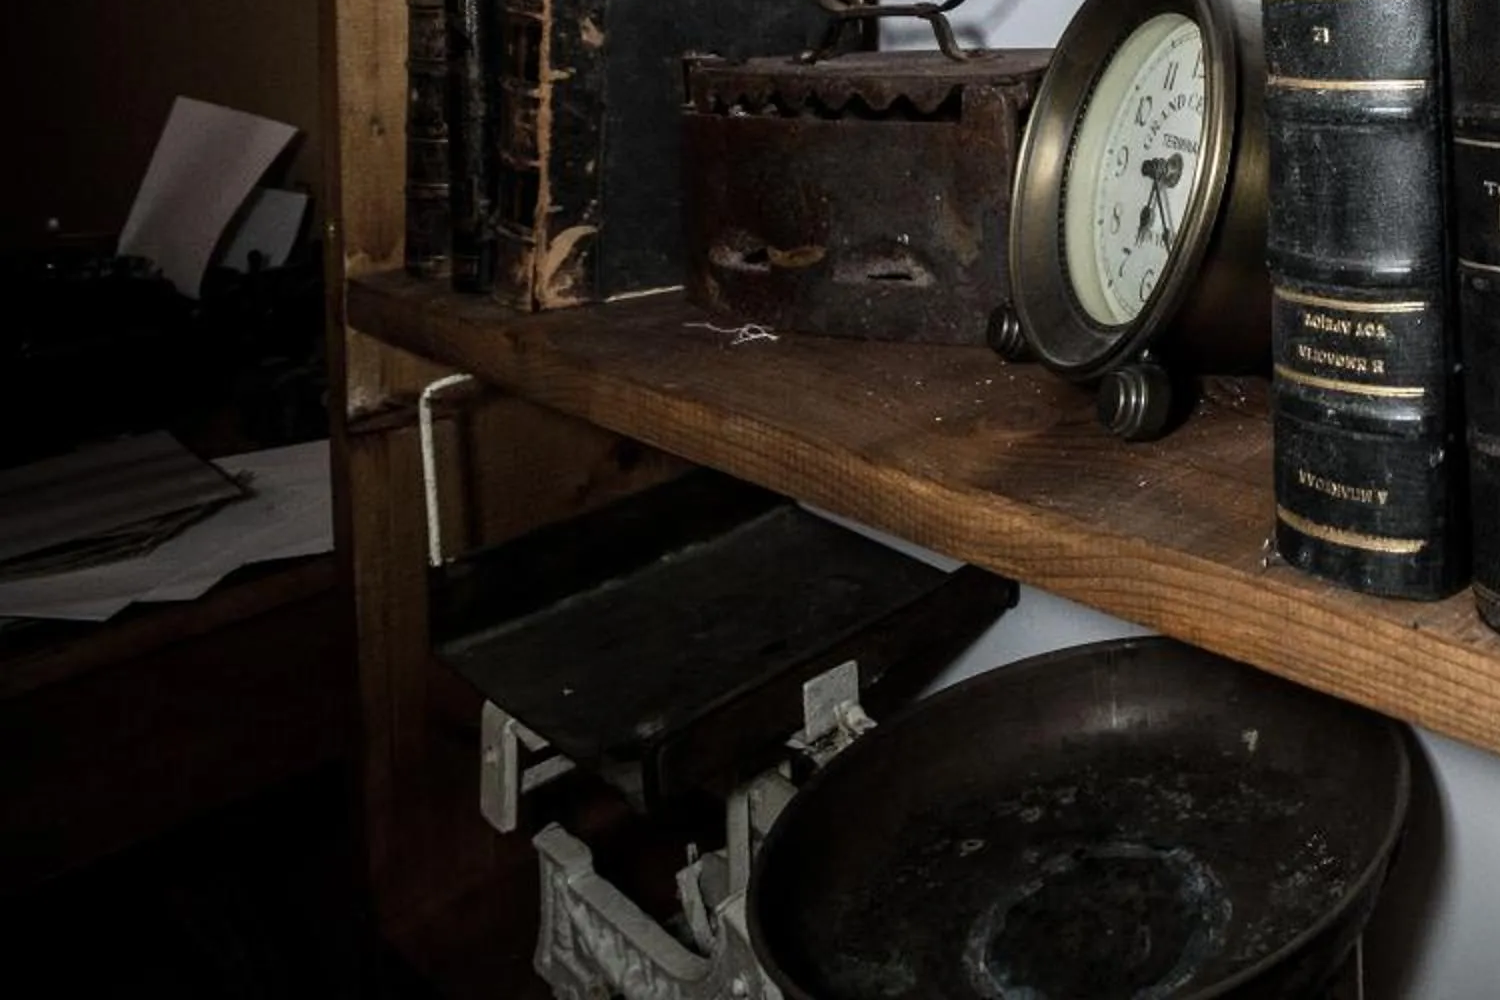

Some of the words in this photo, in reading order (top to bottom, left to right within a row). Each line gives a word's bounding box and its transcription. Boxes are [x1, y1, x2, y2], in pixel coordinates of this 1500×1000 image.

[1162, 61, 1180, 91] 11
[1134, 95, 1154, 128] 10
[1116, 146, 1129, 177] 9
[1110, 205, 1121, 235] 8
[1119, 247, 1132, 278] 7
